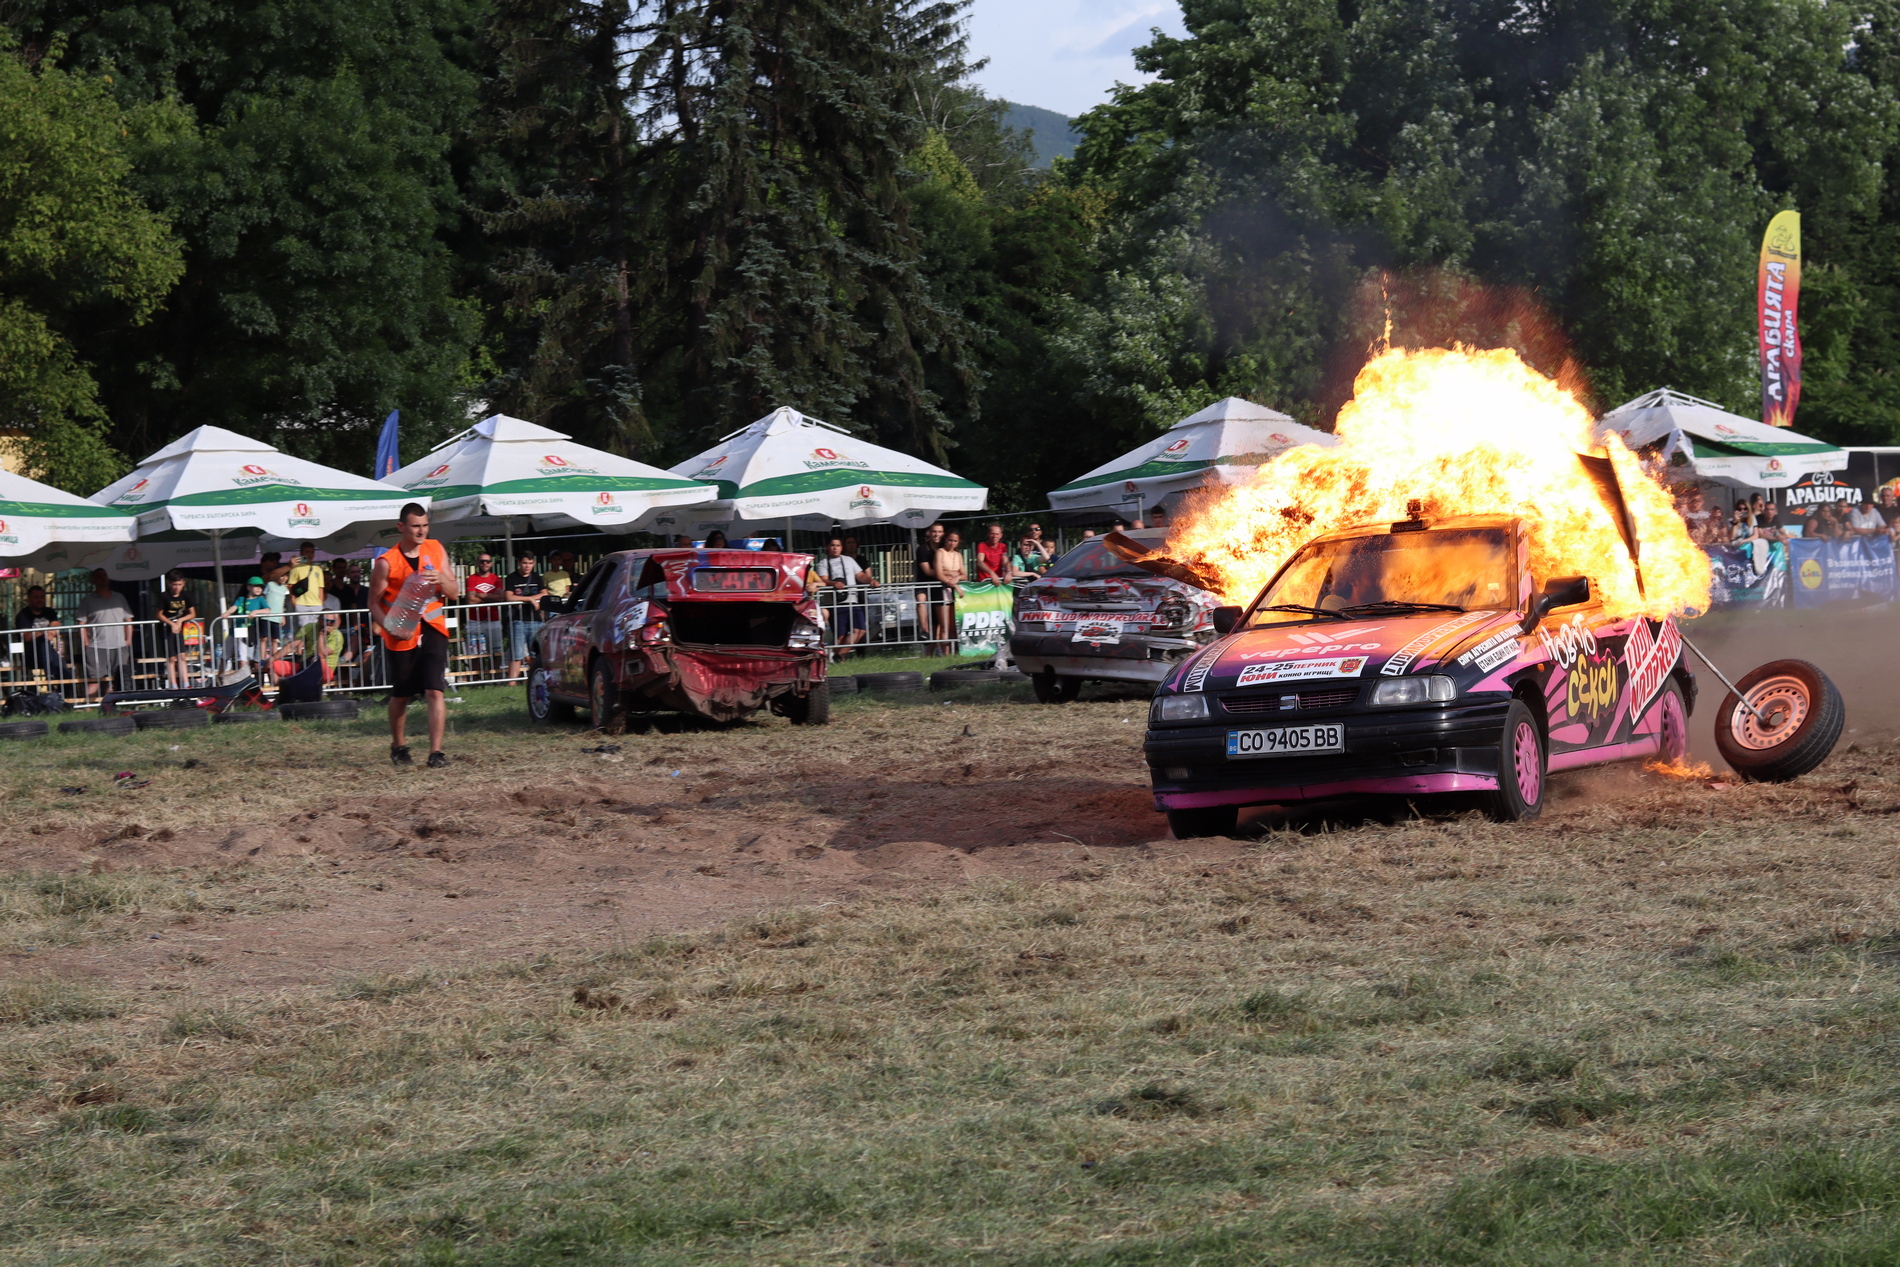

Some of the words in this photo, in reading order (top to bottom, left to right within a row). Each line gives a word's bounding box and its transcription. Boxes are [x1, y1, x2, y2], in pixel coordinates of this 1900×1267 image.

[962, 610, 1006, 629] PDR
[1240, 643, 1381, 660] vapepro
[1244, 662, 1294, 674] 24-25
[1293, 661, 1337, 669] ПЕРНИК
[1240, 672, 1277, 683] ЮНИ
[1278, 671, 1302, 679] КОННО
[1267, 729, 1310, 750] 9405
